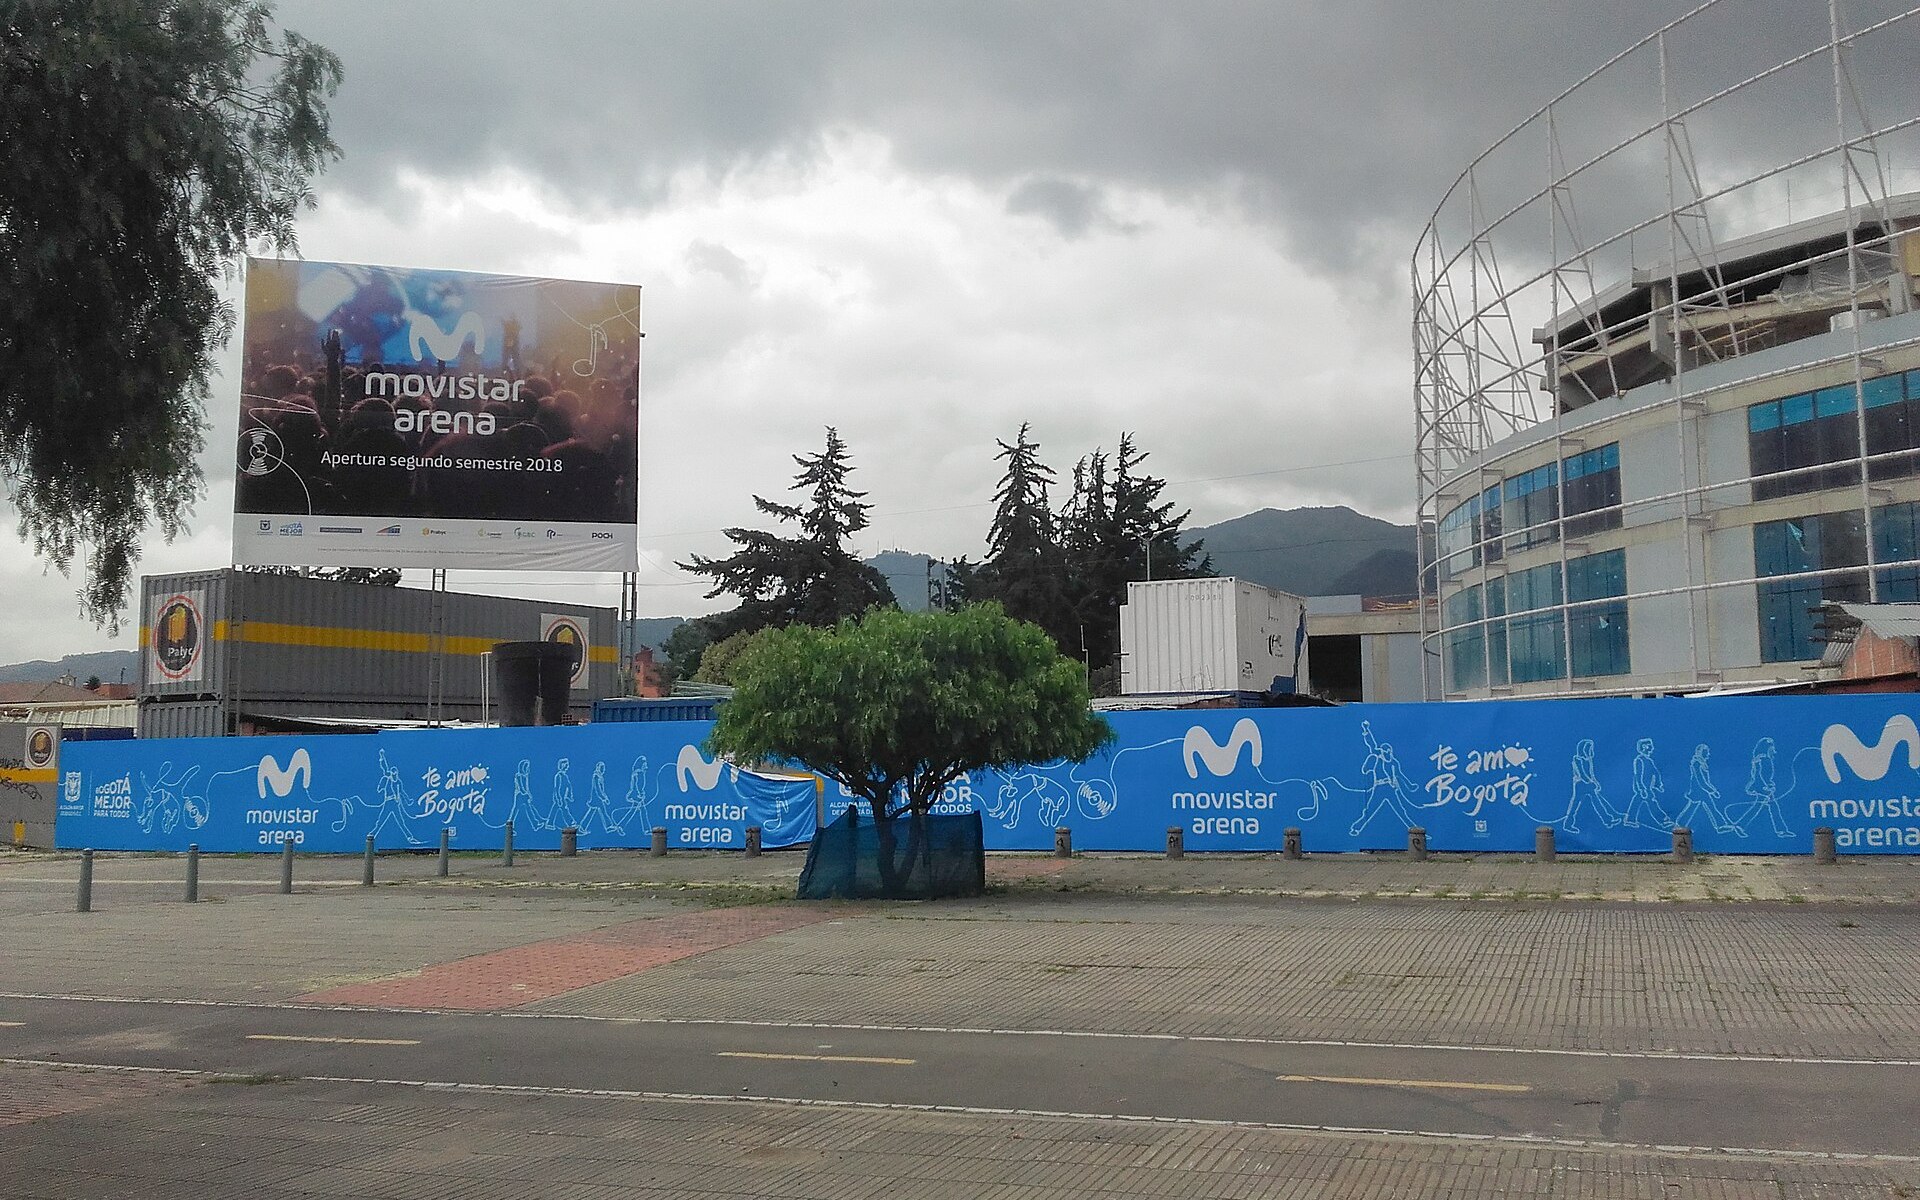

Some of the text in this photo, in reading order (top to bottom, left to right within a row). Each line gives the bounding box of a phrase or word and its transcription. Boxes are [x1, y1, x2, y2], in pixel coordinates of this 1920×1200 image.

[364, 372, 526, 402] movistar
[394, 408, 496, 436] arena
[320, 450, 564, 472] Apertura segundo semestre 2018
[1429, 744, 1458, 771] te
[421, 766, 441, 788] te
[94, 795, 131, 810] MEJOR
[1171, 789, 1278, 809] movistar
[1423, 773, 1532, 817] Bogotá
[93, 809, 131, 819] PARA TODOS
[246, 807, 319, 824] movistar
[416, 788, 489, 824] Bogotá
[664, 802, 749, 821] movistar
[933, 804, 972, 814] TODOS
[680, 827, 733, 843] arena
[1191, 817, 1260, 835] arena
[1836, 827, 1920, 847] arena
